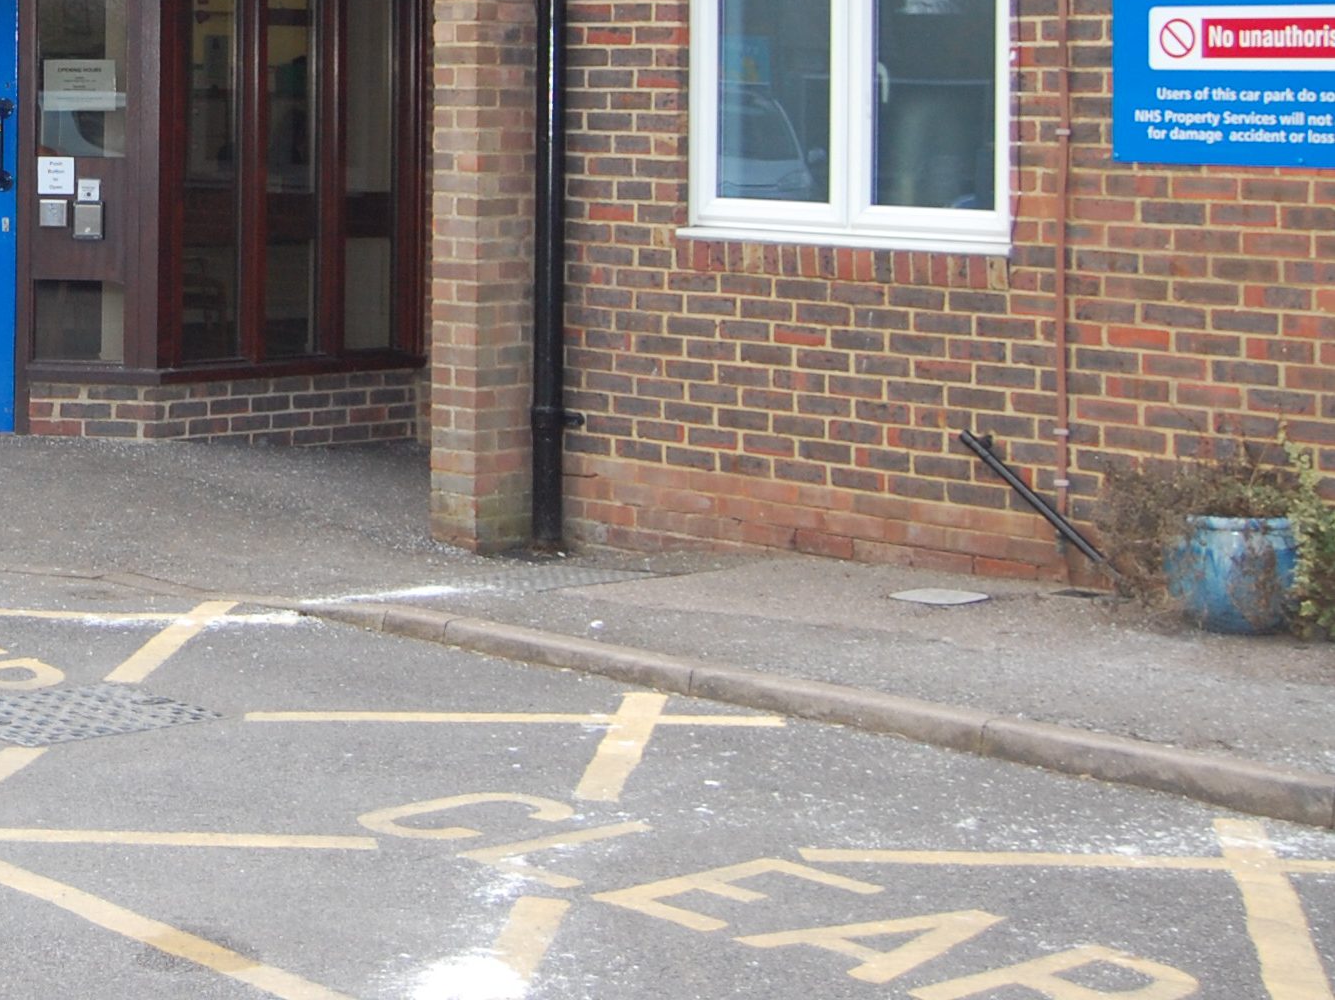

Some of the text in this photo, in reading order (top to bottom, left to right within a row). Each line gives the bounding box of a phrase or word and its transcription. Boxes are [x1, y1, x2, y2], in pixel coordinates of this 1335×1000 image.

[1207, 24, 1235, 48] No
[1156, 87, 1193, 101] Users
[1194, 87, 1210, 101] of
[1212, 87, 1237, 101] this
[1239, 89, 1261, 102] car
[1263, 87, 1296, 105] park
[1297, 87, 1318, 103] do
[1134, 109, 1334, 127] NHS Property Services will not
[1147, 126, 1168, 140] for
[1169, 126, 1224, 144] damage
[1228, 128, 1287, 143] accident
[1288, 131, 1306, 144] or
